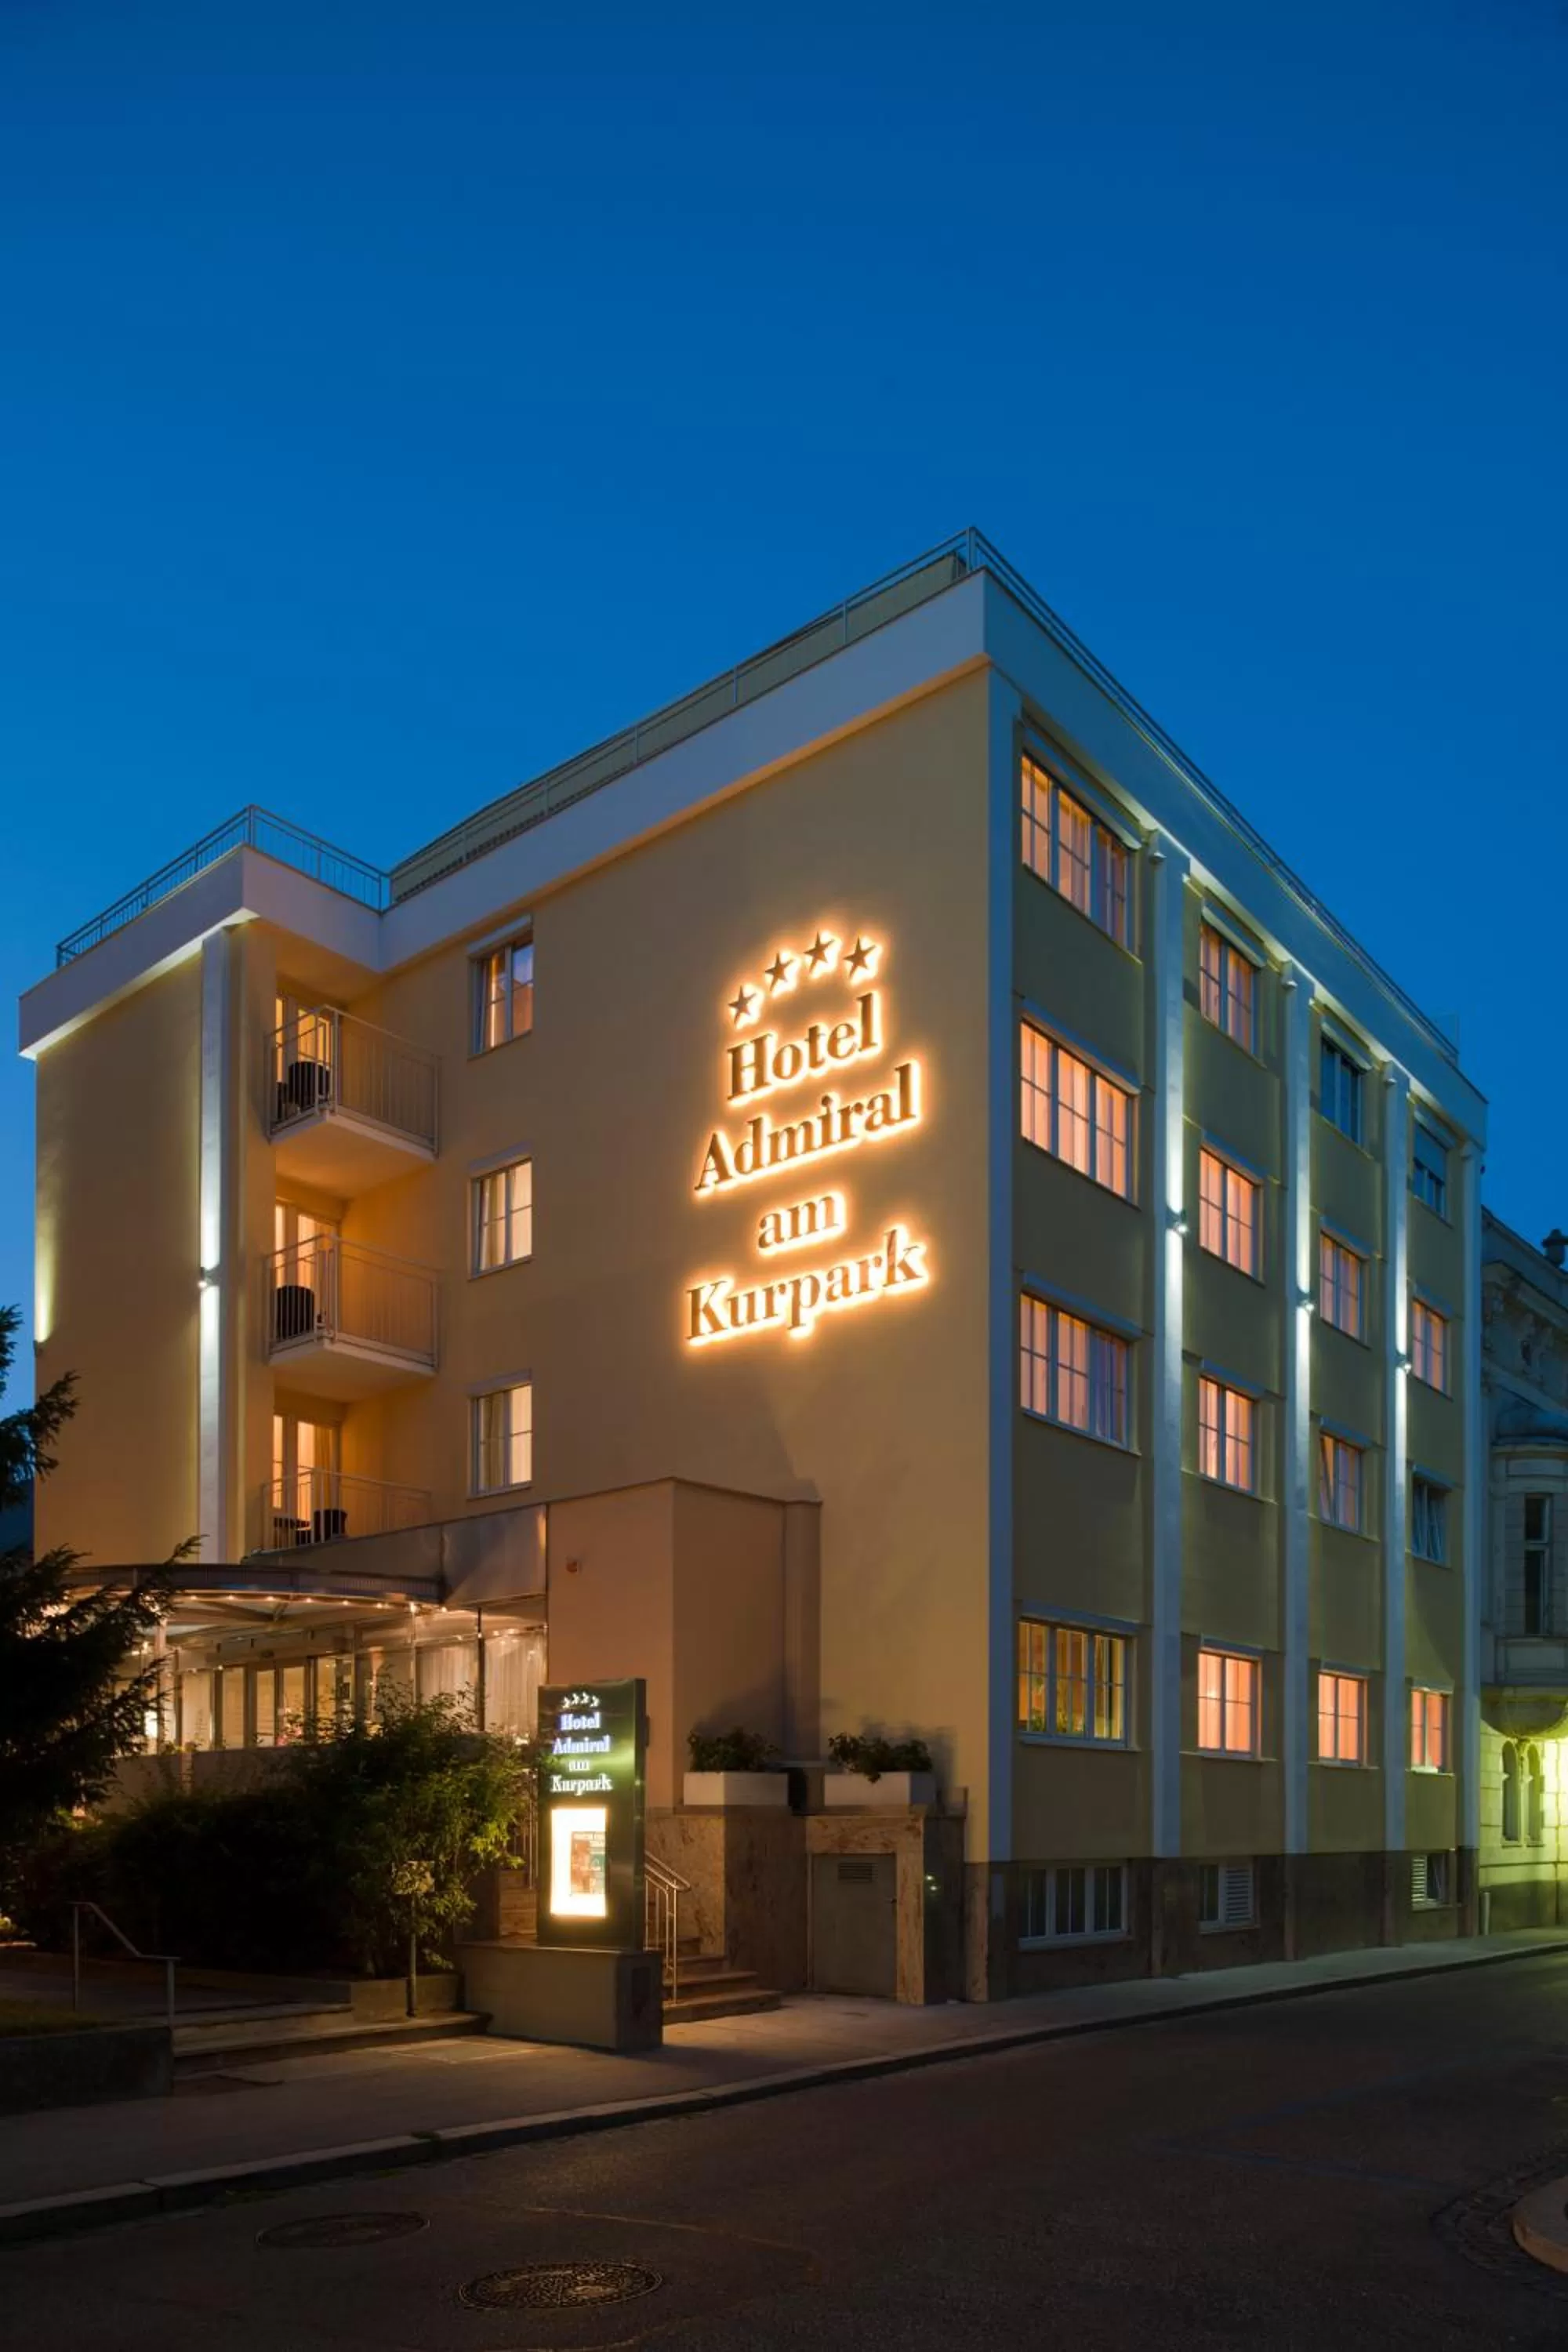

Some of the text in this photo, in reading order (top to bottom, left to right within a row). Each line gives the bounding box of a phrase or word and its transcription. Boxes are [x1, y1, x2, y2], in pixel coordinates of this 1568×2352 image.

[726, 992, 879, 1101] Hotel
[693, 1062, 916, 1191] Admiral
[758, 1194, 839, 1250] am
[686, 1229, 924, 1341] Kurpark
[554, 1735, 610, 1755] Admiral
[560, 1711, 601, 1730] Hotel
[551, 1773, 612, 1795] Kurpark
